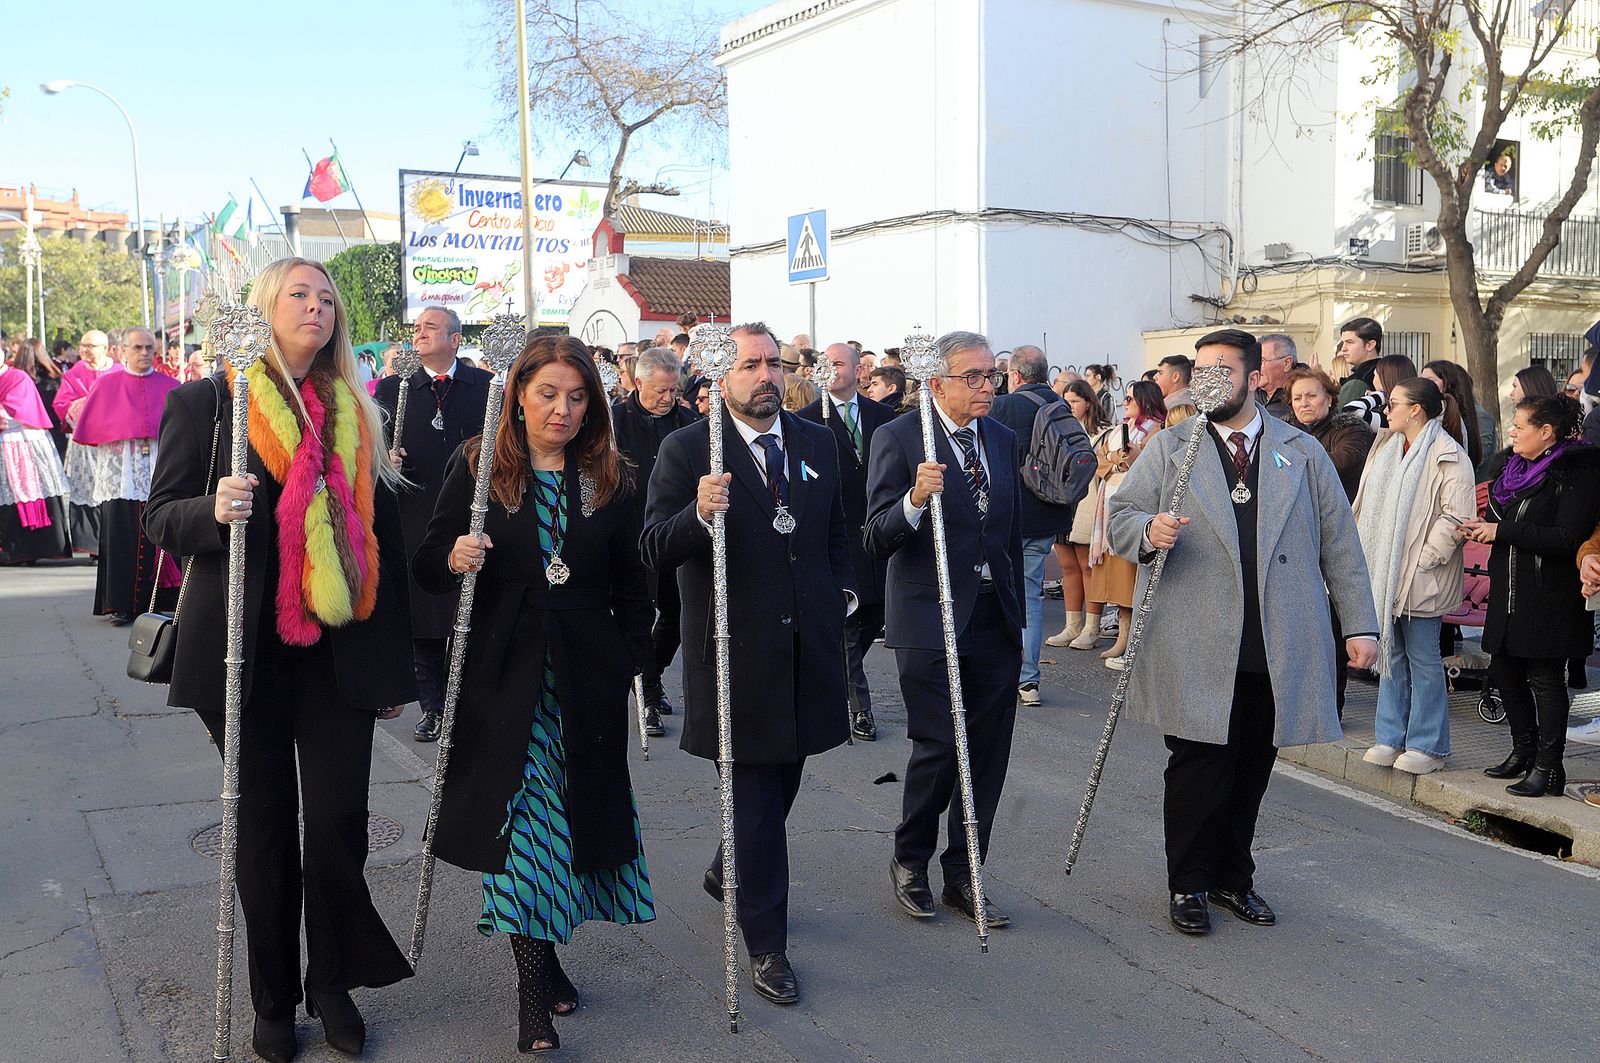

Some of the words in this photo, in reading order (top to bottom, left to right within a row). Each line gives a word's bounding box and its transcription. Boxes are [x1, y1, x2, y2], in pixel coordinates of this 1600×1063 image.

[445, 179, 456, 195] el
[459, 184, 562, 212] Invernaero
[468, 210, 511, 229] Centro
[409, 231, 438, 248] Los
[443, 232, 570, 254] MONTADTOS
